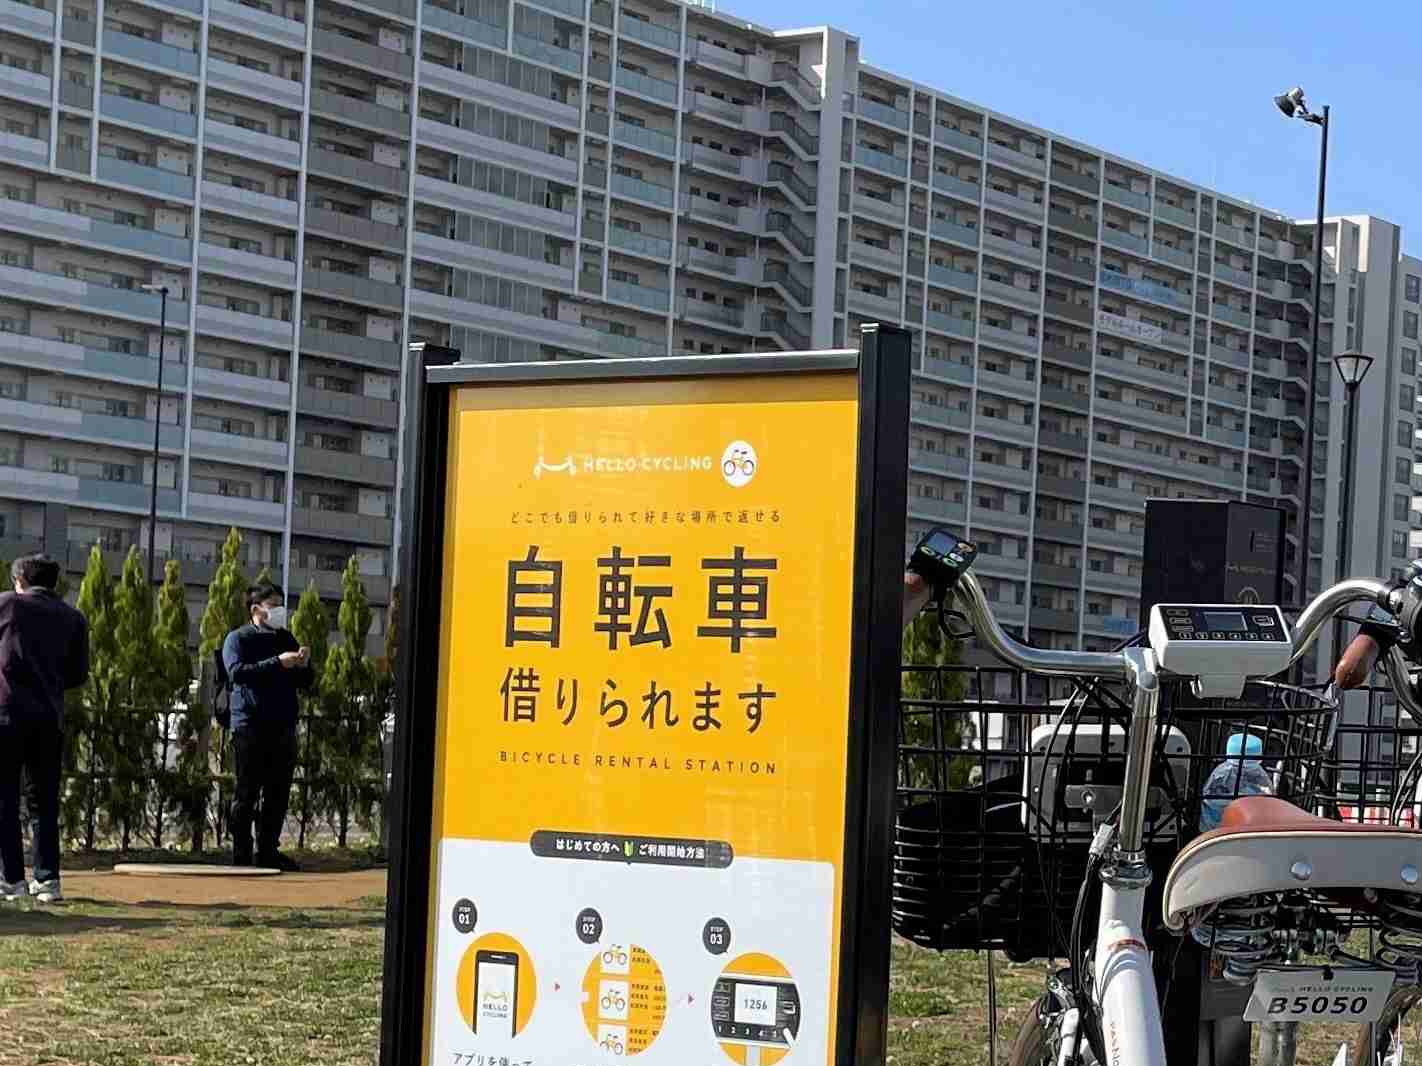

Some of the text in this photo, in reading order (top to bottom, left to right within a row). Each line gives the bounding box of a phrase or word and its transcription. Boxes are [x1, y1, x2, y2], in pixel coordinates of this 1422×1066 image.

[583, 457, 712, 472] HELLO CYCLING
[505, 545, 777, 653] 自転車
[500, 667, 777, 733] 借りられます
[500, 751, 777, 775] BICYCLE RENTAL STATION
[459, 913, 470, 924] 01
[582, 923, 595, 934] 02
[710, 934, 723, 944] 03
[1268, 996, 1368, 1015] B5050
